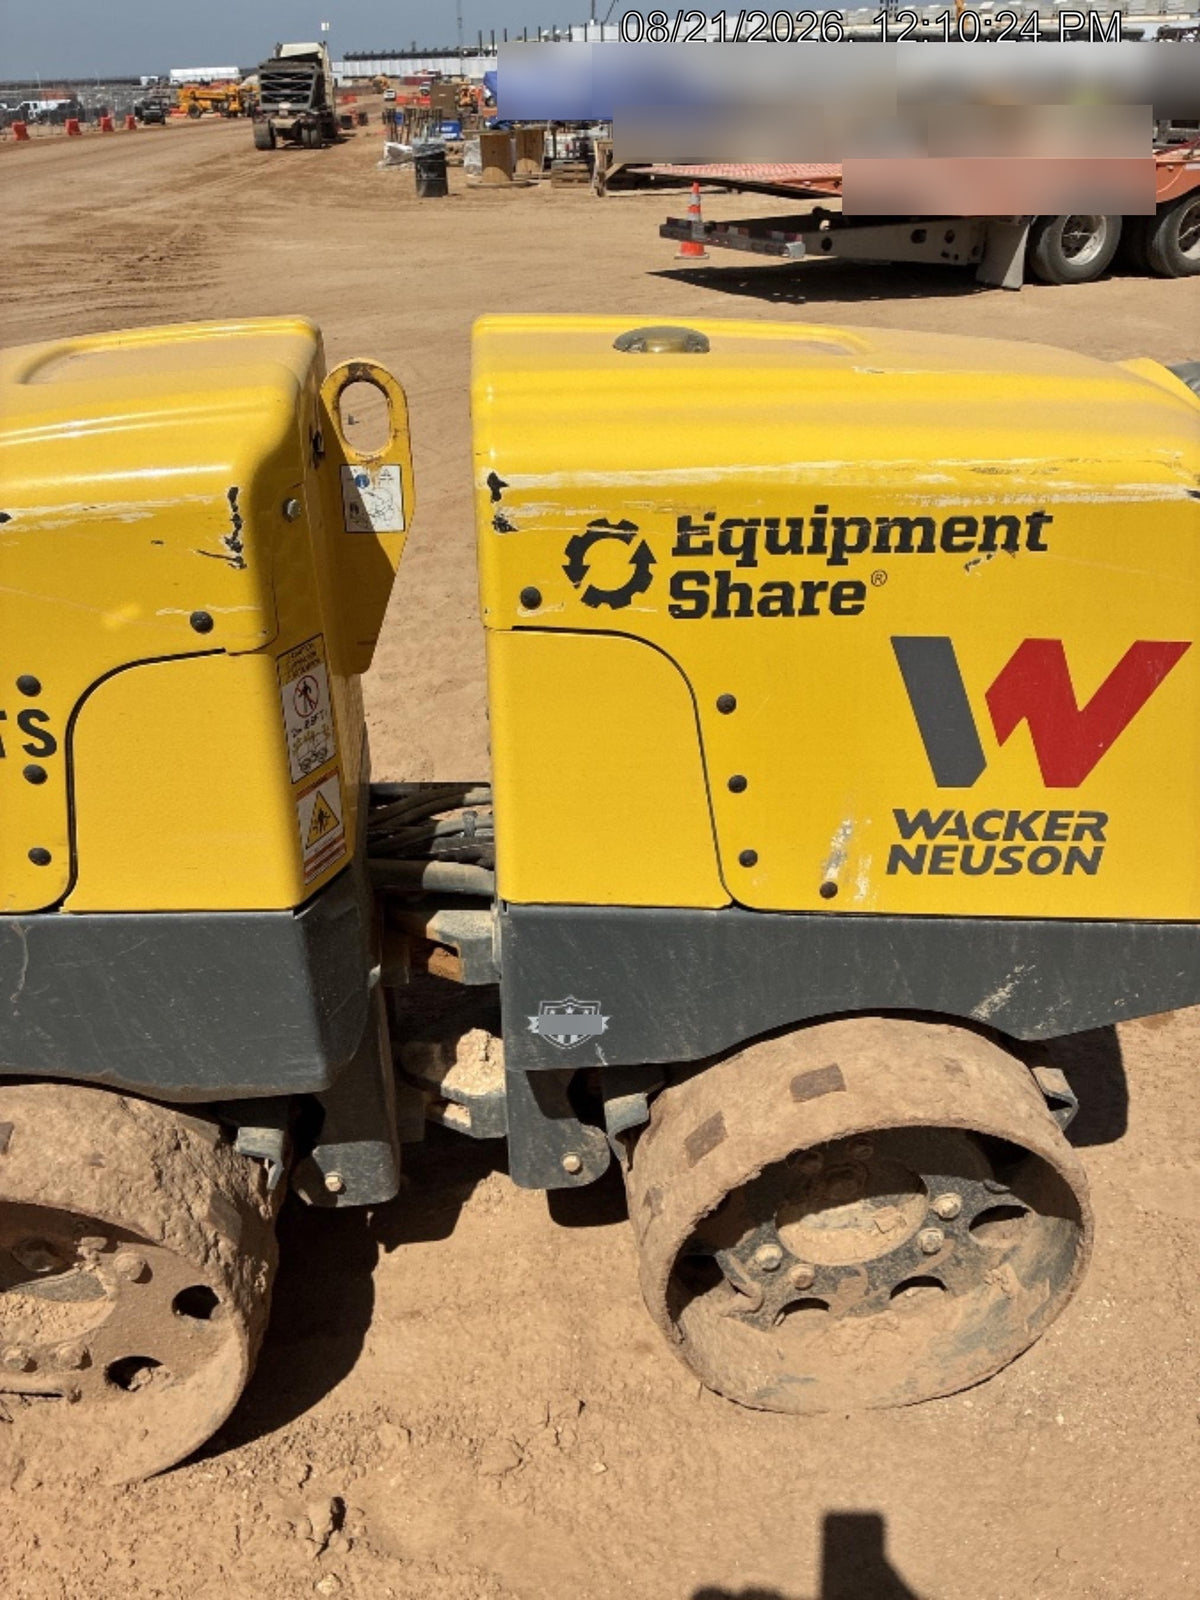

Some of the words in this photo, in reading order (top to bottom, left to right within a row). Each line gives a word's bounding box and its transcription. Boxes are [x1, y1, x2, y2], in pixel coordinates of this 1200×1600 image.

[671, 504, 1053, 568] Equipment
[892, 808, 1109, 842] WACKER
[886, 843, 1105, 876] NEUSON
